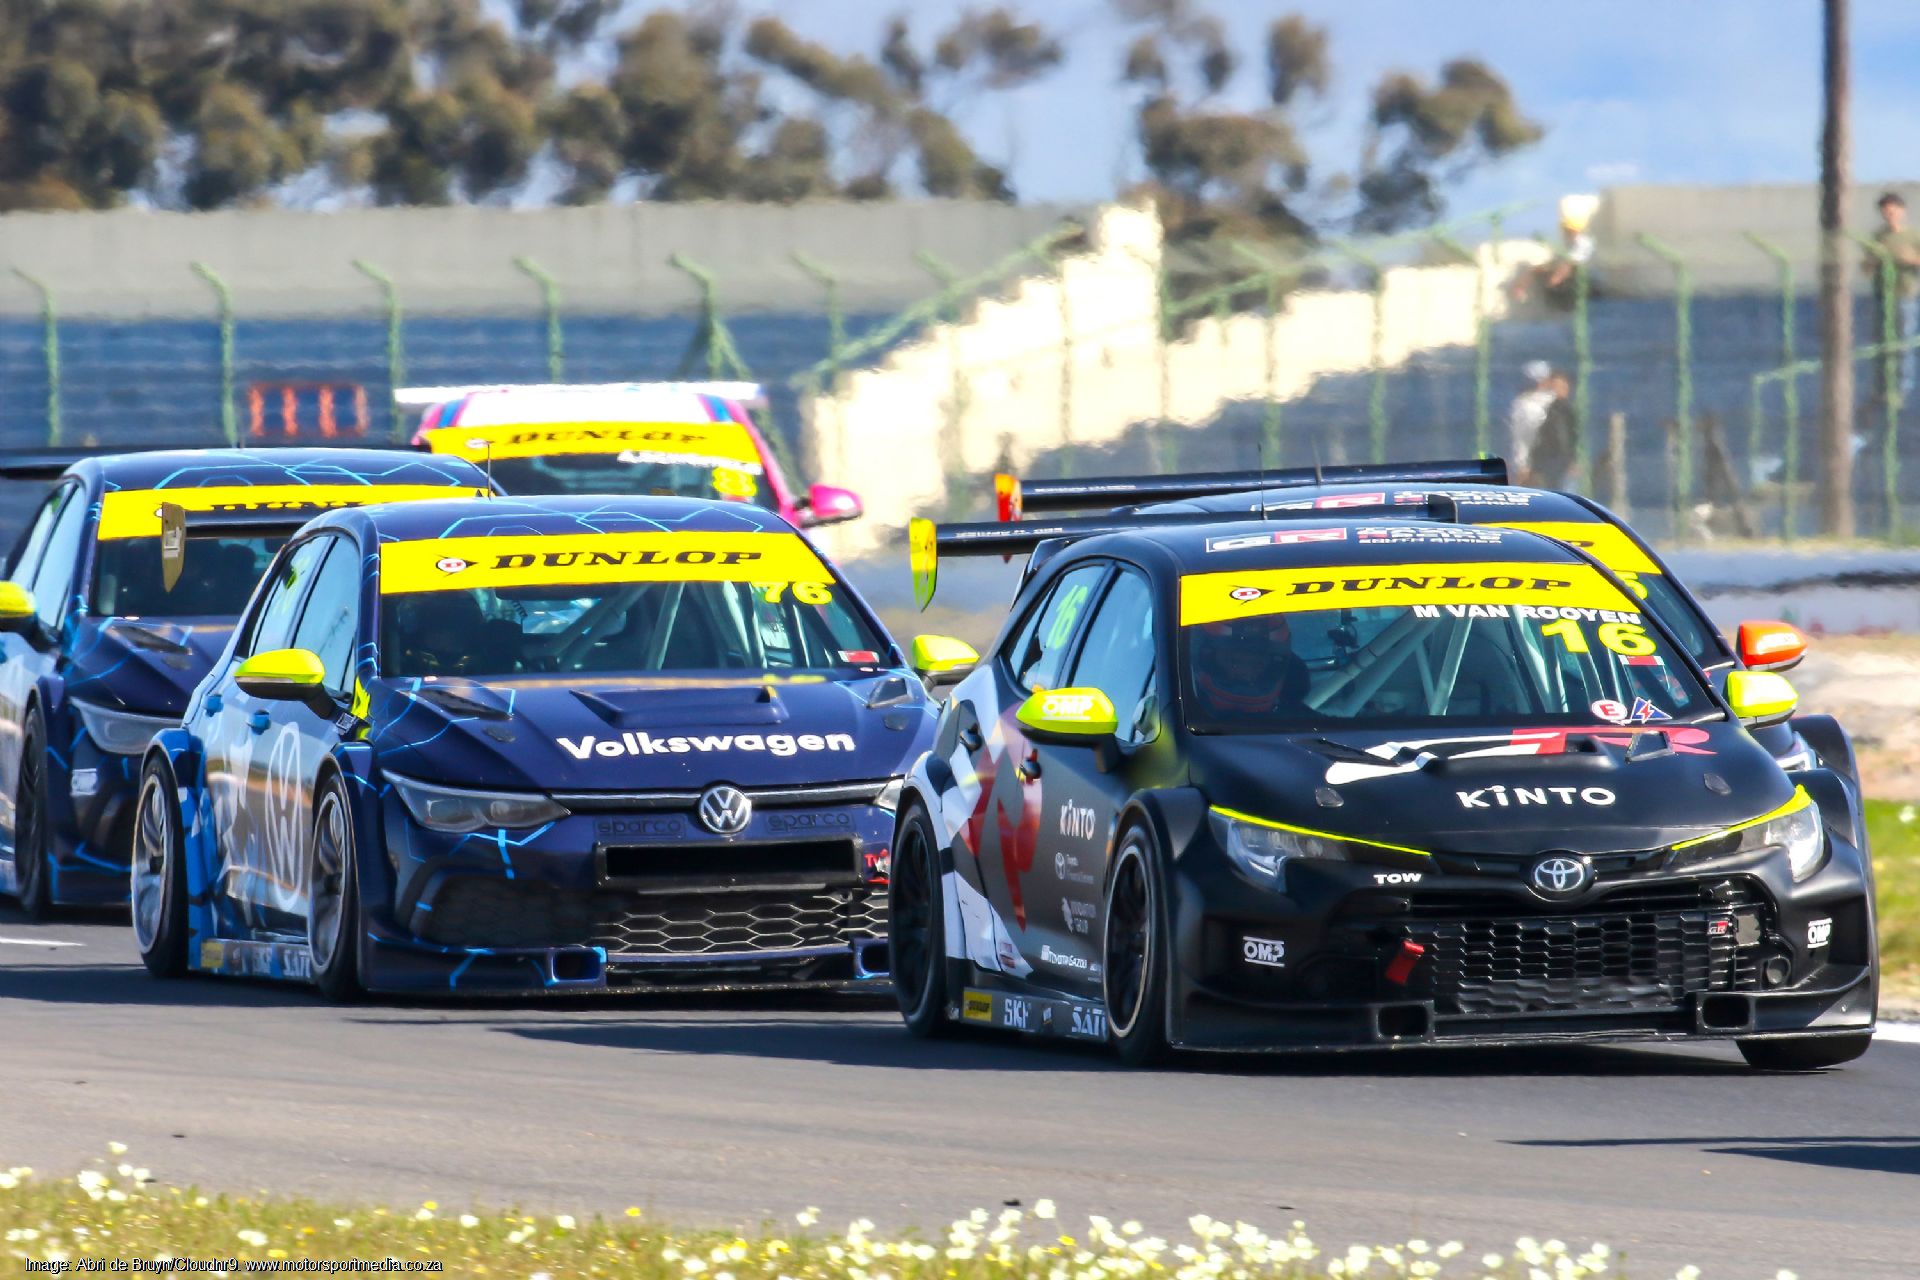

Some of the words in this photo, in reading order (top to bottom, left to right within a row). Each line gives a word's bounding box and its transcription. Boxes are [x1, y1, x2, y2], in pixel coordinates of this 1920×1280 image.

[509, 430, 707, 445] DUNLOP
[490, 551, 763, 570] DUNLOP
[752, 581, 833, 605] 76
[1285, 576, 1572, 596] DUNLOP
[1046, 585, 1089, 649] 16
[1412, 605, 1440, 618] M
[1445, 604, 1510, 618] VAN
[1515, 605, 1642, 625] ROOYEN
[1541, 618, 1657, 656] 16
[1042, 699, 1093, 718] OMP
[1600, 704, 1620, 716] E
[556, 732, 855, 759] Volkswagen
[1373, 873, 1422, 885] TOW
[1807, 924, 1831, 944] OMP
[1244, 941, 1285, 963] OMP
